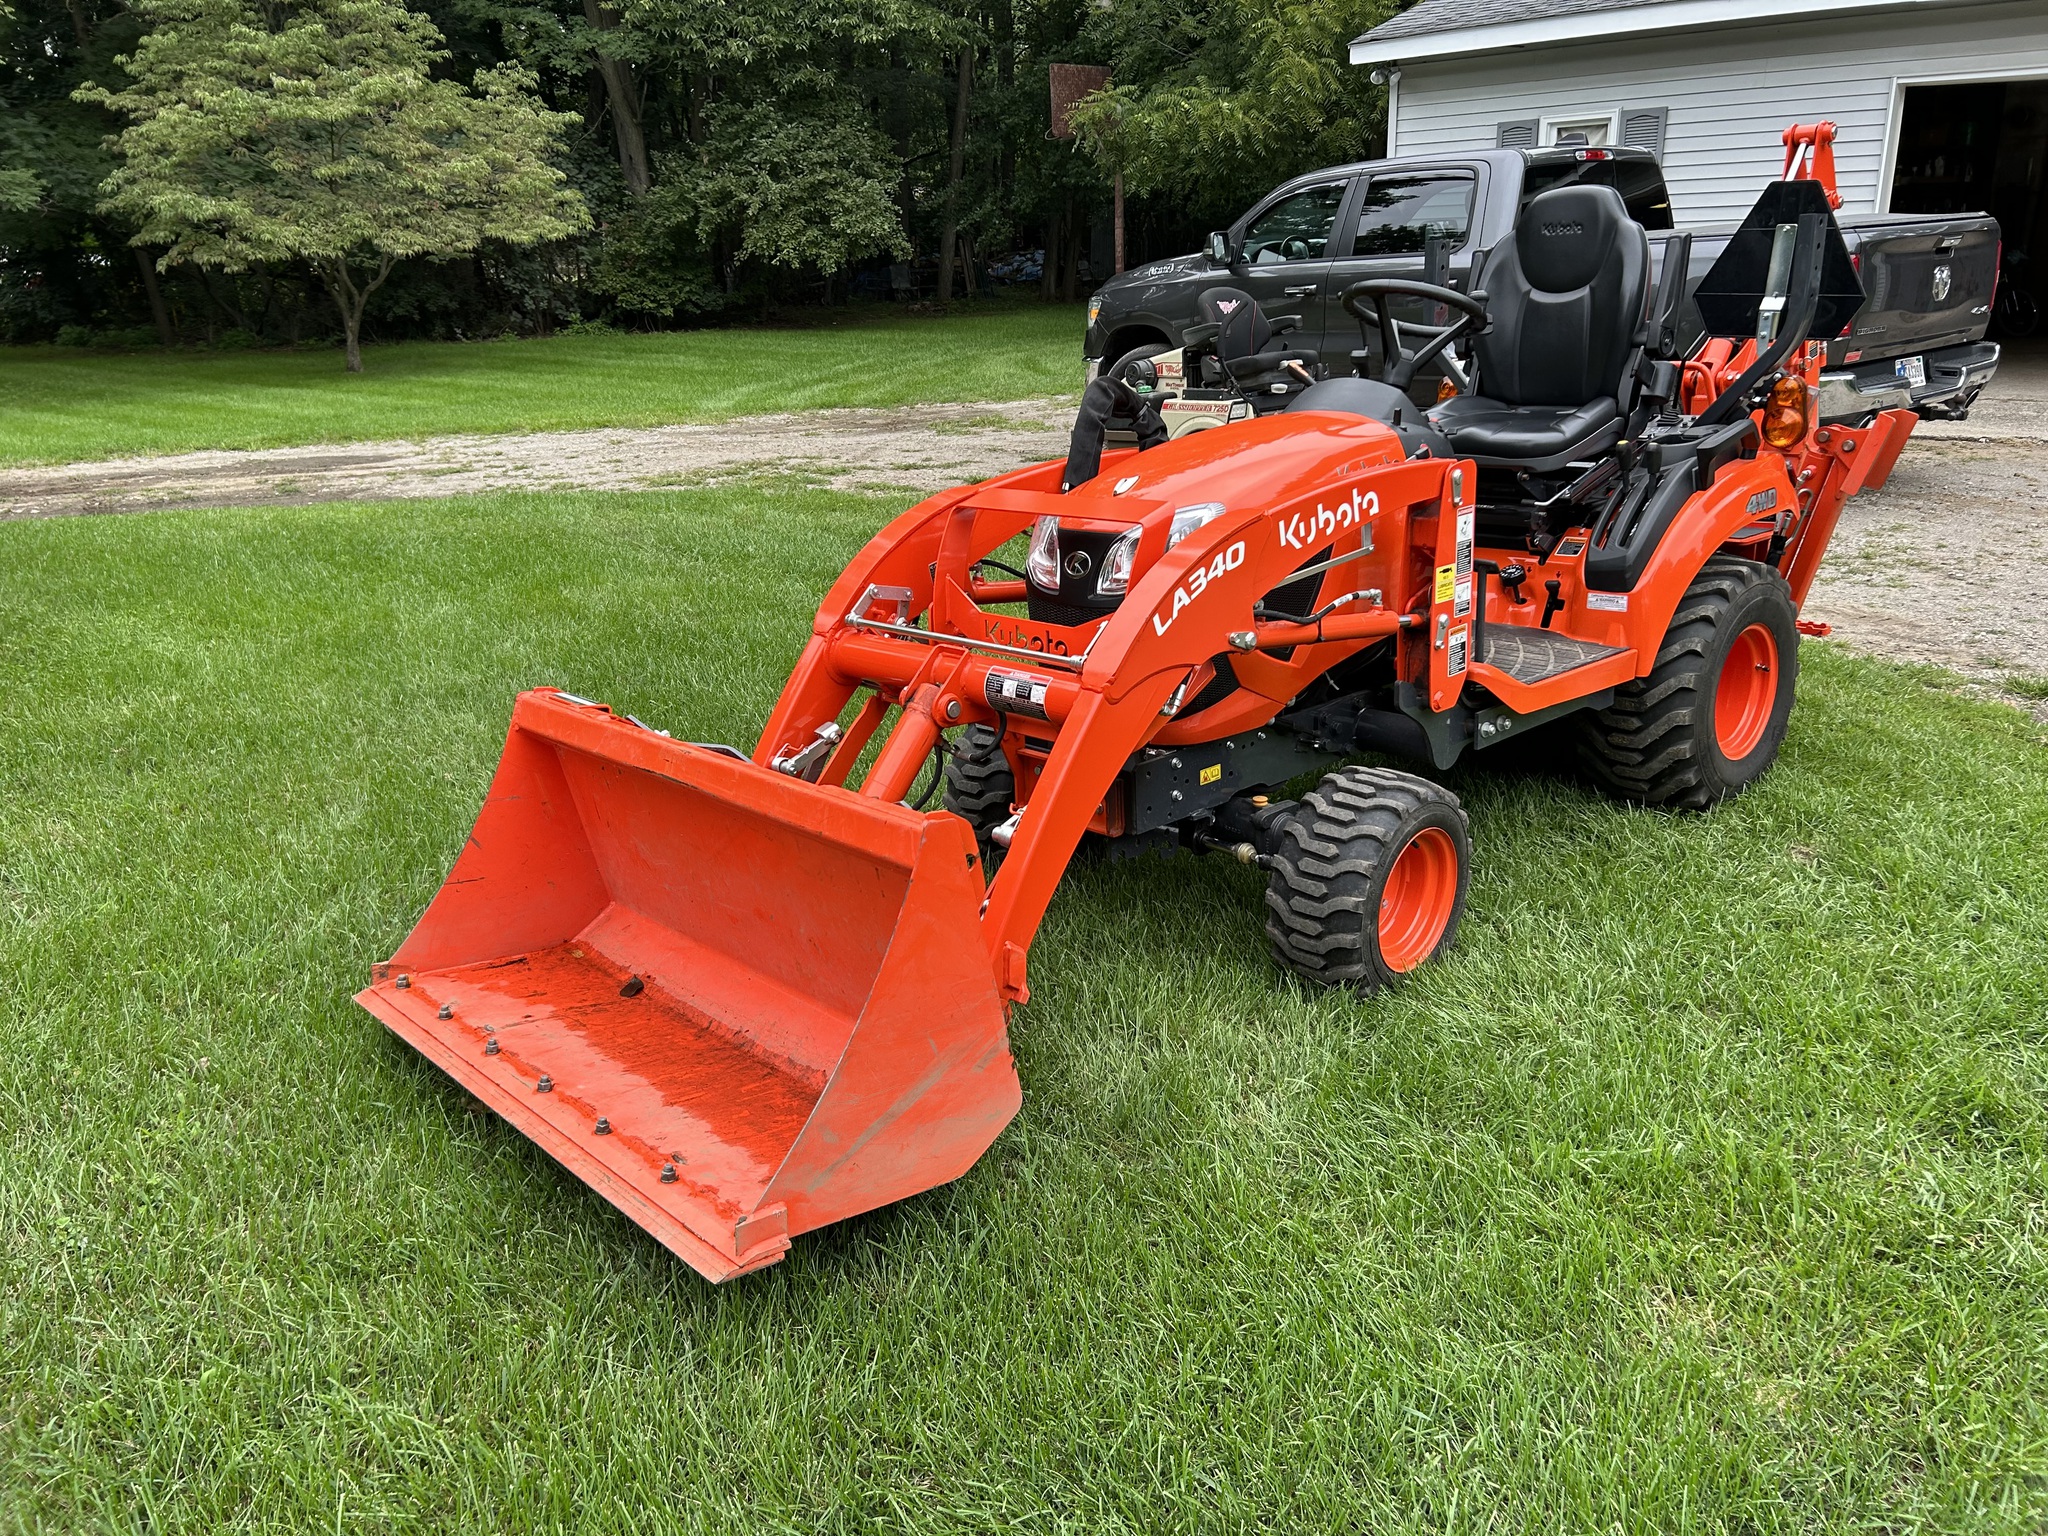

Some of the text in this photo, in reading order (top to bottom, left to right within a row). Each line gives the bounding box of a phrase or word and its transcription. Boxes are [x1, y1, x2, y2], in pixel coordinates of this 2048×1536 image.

[1541, 220, 1584, 236] Kubota
[1168, 404, 1229, 413] GRASSHOPPER 725D
[1745, 487, 1777, 515] 4WD
[1279, 487, 1380, 550] Kubota
[1152, 540, 1246, 637] LA340
[984, 619, 1069, 657] Kubota
